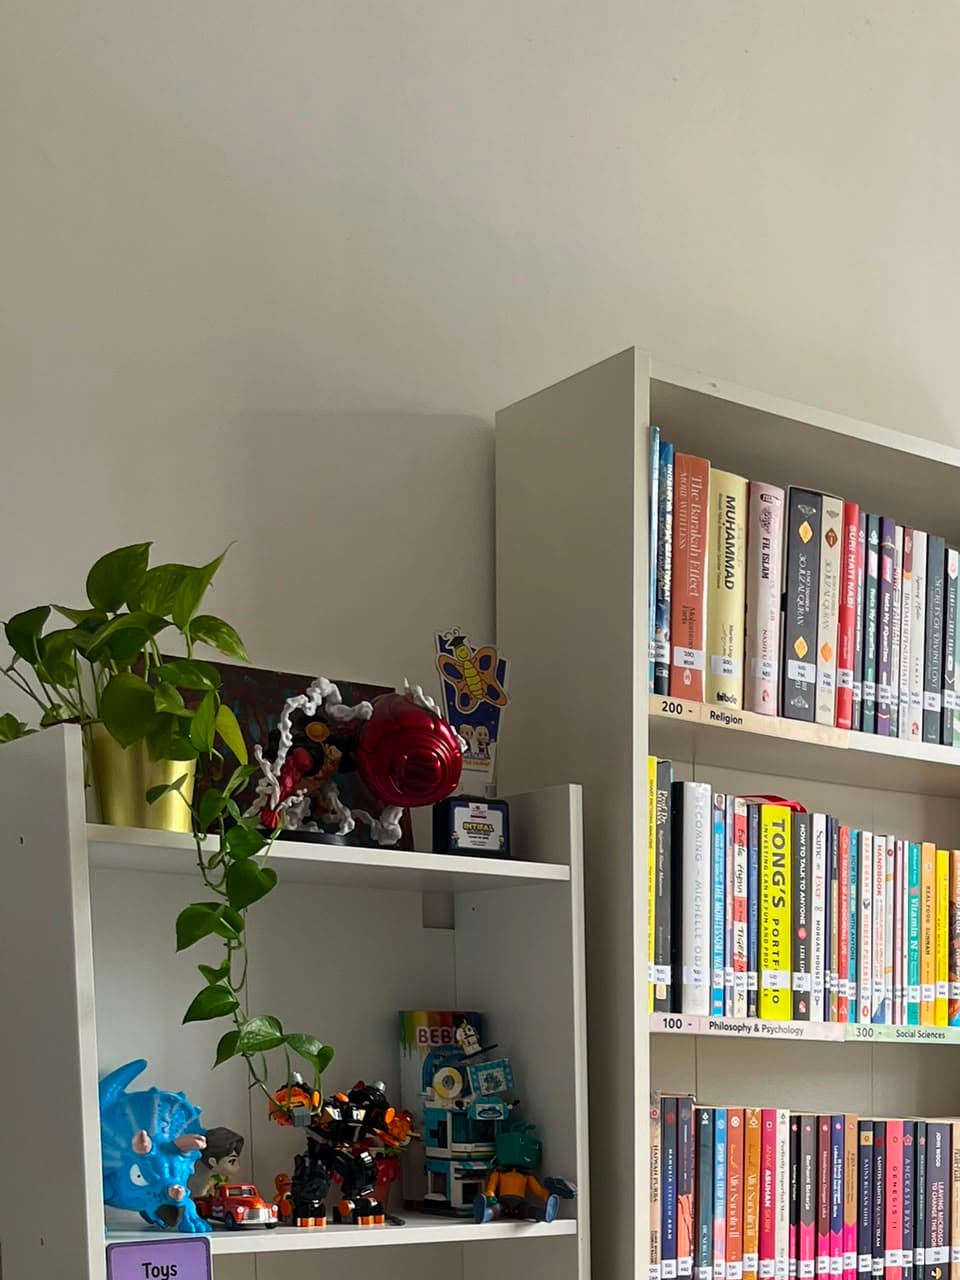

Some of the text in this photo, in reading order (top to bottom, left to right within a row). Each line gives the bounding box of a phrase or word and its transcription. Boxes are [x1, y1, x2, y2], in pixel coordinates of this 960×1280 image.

[759, 553, 770, 579] ISLAM
[662, 701, 683, 715] 200
[709, 711, 743, 726] Religion
[799, 845, 806, 857] TO
[771, 819, 786, 908] TONG'S
[799, 878, 806, 890] TO
[910, 897, 919, 937] Vitamin
[771, 918, 781, 1005] PORTFIO
[662, 1018, 682, 1030] 100
[708, 1020, 804, 1038] Philosophy & Psychology
[856, 1028, 874, 1039] 300
[896, 1029, 946, 1040] Social Sciences
